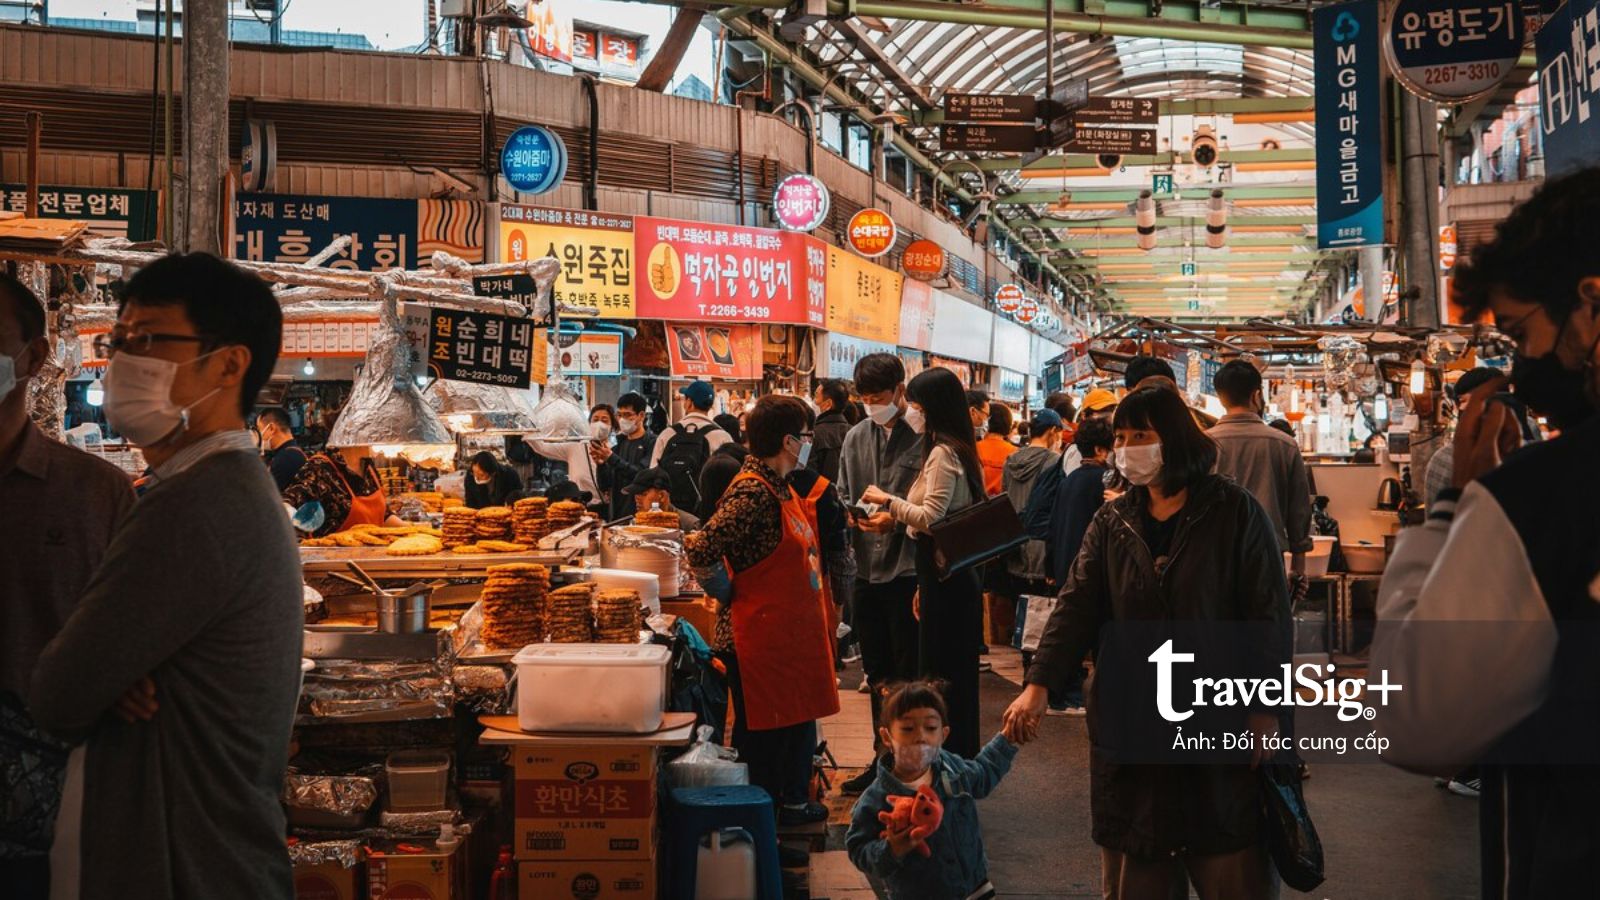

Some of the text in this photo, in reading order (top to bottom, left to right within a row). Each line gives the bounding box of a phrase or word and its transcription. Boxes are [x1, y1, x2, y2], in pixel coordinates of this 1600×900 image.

[1398, 3, 1515, 50] 유명도기
[1424, 62, 1500, 85] 2267-3310
[504, 149, 551, 168] 수원아줌마
[38, 192, 129, 216] 전문업체
[282, 203, 330, 221] 도산매
[852, 225, 890, 238] 순대국밥
[480, 278, 513, 292] 박가네
[699, 304, 770, 318] T.2266-3439
[456, 316, 532, 347] 순희네
[455, 341, 530, 373] 빈대떡
[455, 368, 519, 384] 02-2273-5057
[534, 785, 631, 815] 환만식초
[529, 871, 555, 879] LOTTE
